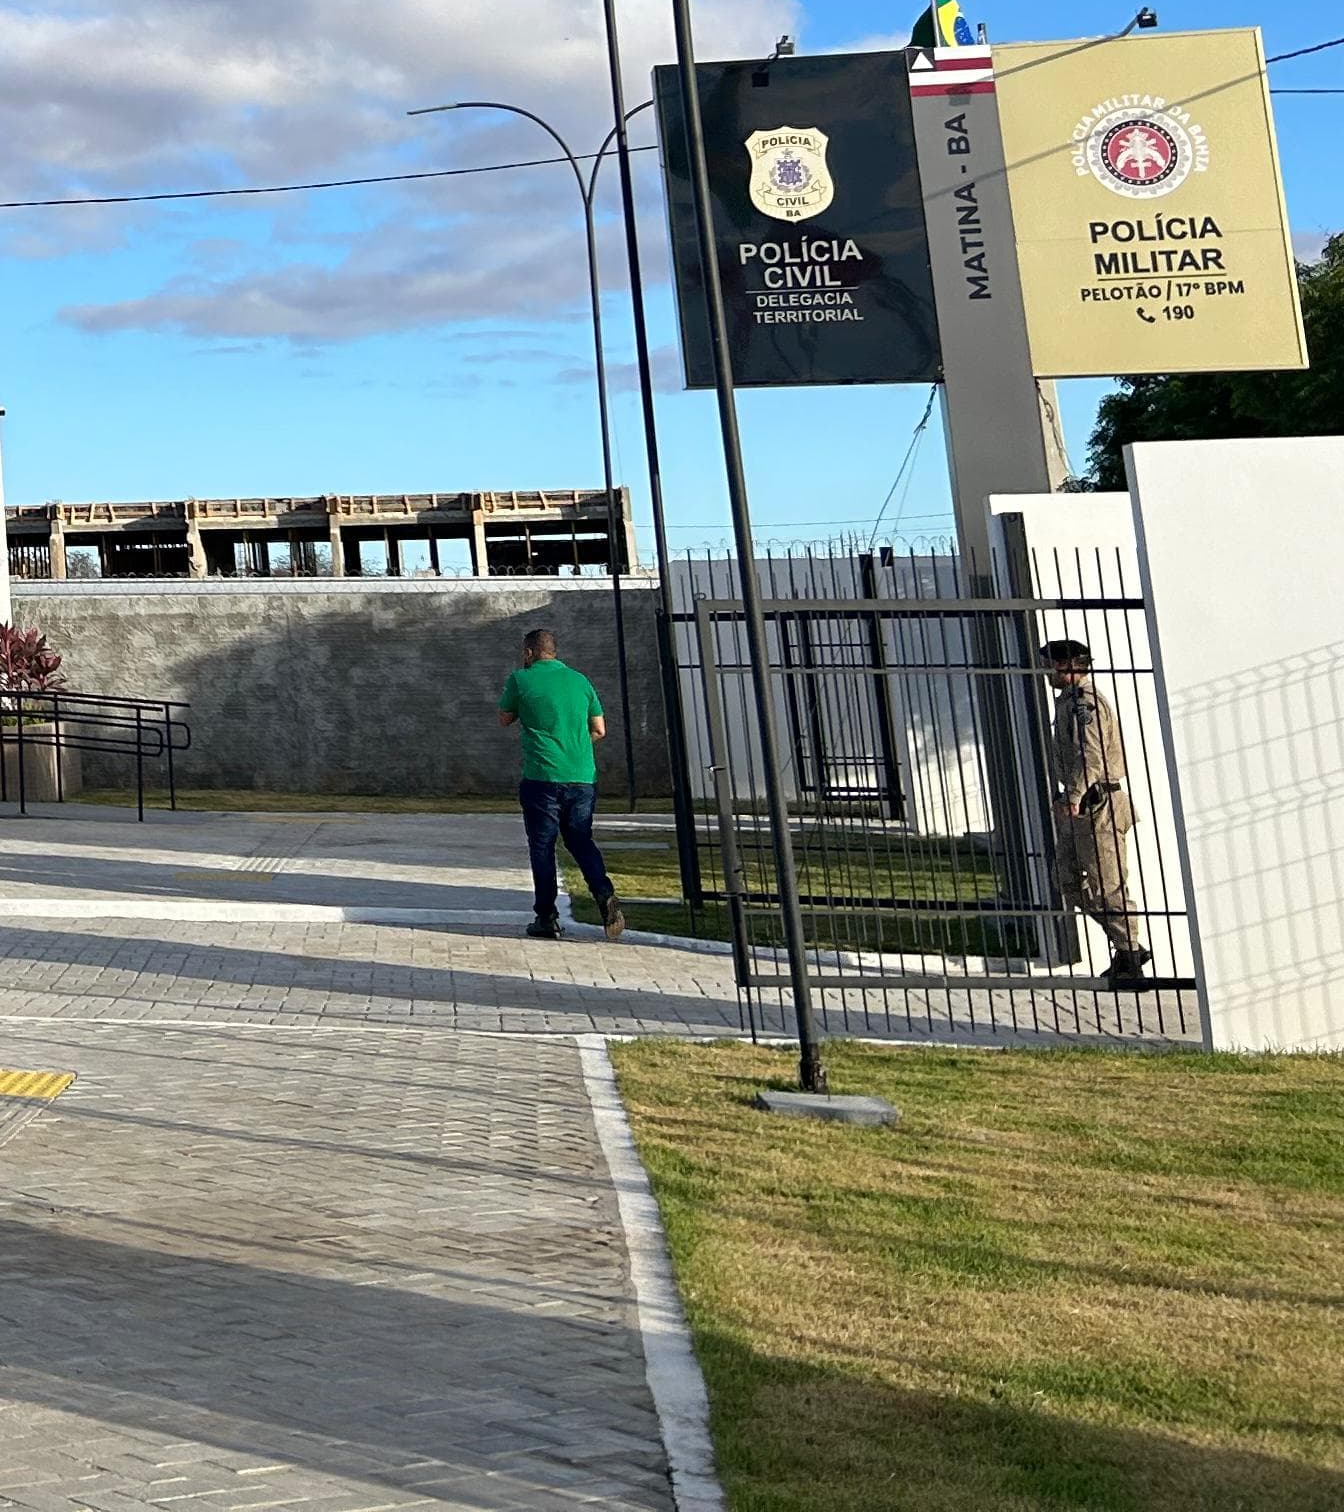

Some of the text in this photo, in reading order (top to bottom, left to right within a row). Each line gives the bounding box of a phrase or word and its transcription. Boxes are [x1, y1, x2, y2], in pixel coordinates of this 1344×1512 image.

[944, 113, 971, 155] BA
[1091, 94, 1166, 119] MILITAR
[1168, 105, 1191, 126] DA
[1188, 123, 1210, 173] BAHIA
[776, 197, 810, 206] CIVIL
[786, 209, 802, 217] BA
[1088, 213, 1223, 244] POLÍCIA
[739, 236, 863, 265] POLÍCIA
[954, 182, 992, 301] MATINA
[1093, 248, 1226, 275] MILITAR
[763, 265, 842, 289] CIVIL
[756, 292, 853, 307] DELEGACIA
[1080, 283, 1162, 302] PELOTÃO
[1204, 280, 1245, 296] BPM
[753, 308, 864, 324] TERRITORIAL
[1161, 304, 1195, 321] 190
